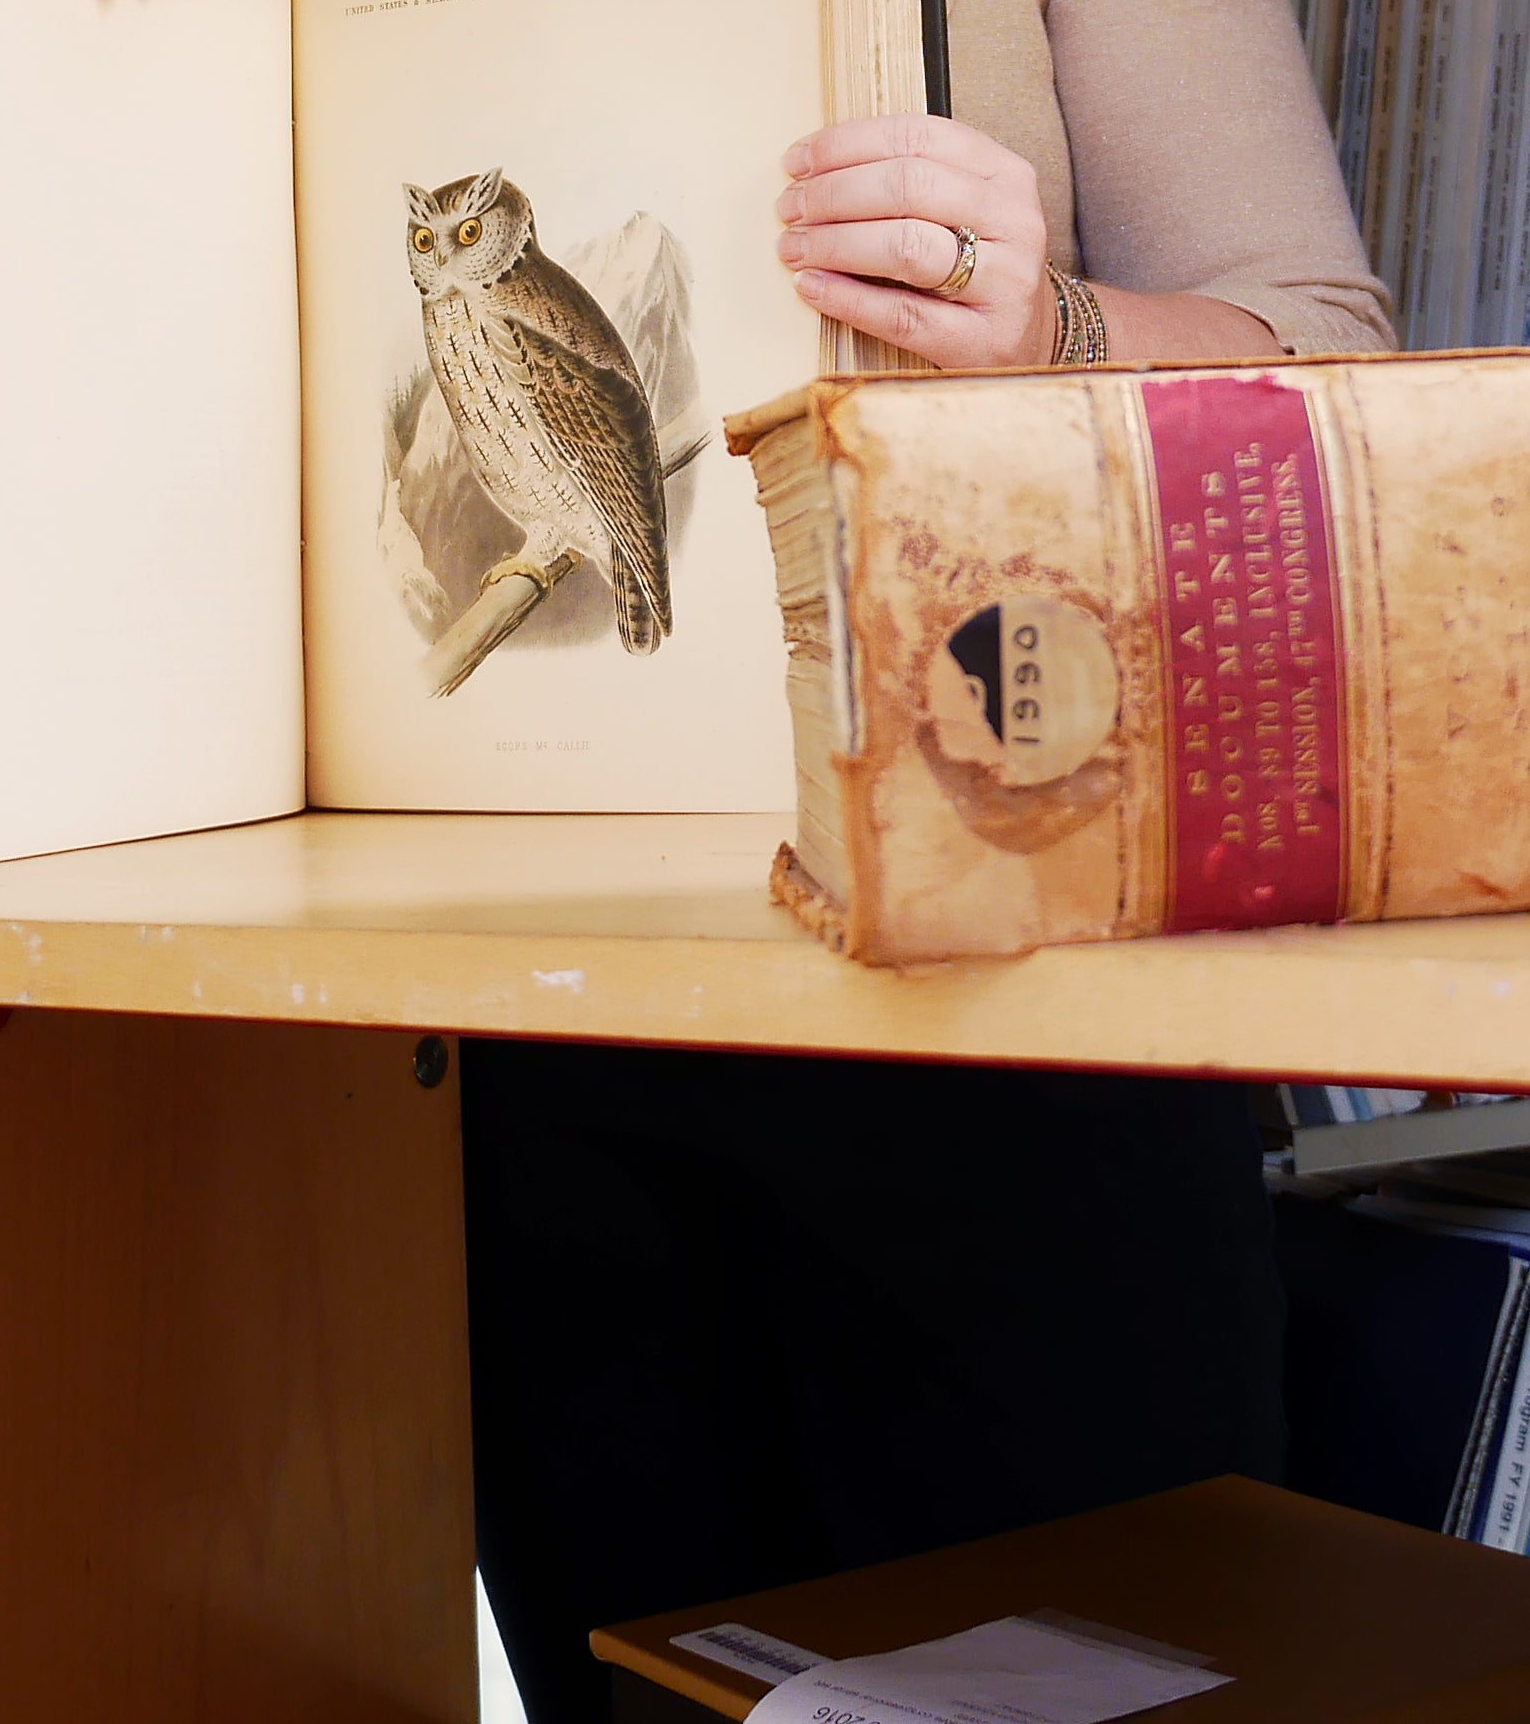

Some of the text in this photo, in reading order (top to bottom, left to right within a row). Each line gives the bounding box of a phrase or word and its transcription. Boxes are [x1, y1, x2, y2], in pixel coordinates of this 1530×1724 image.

[345, 4, 375, 17] UNITED
[1011, 624, 1042, 747] 1990
[1171, 522, 1211, 796] SENATE
[1201, 471, 1248, 844] DOCUMENTS
[1254, 701, 1281, 738] TO
[1292, 676, 1322, 796] SESSION,
[1500, 1493, 1517, 1533] 1991
[1511, 1461, 1524, 1488] FY
